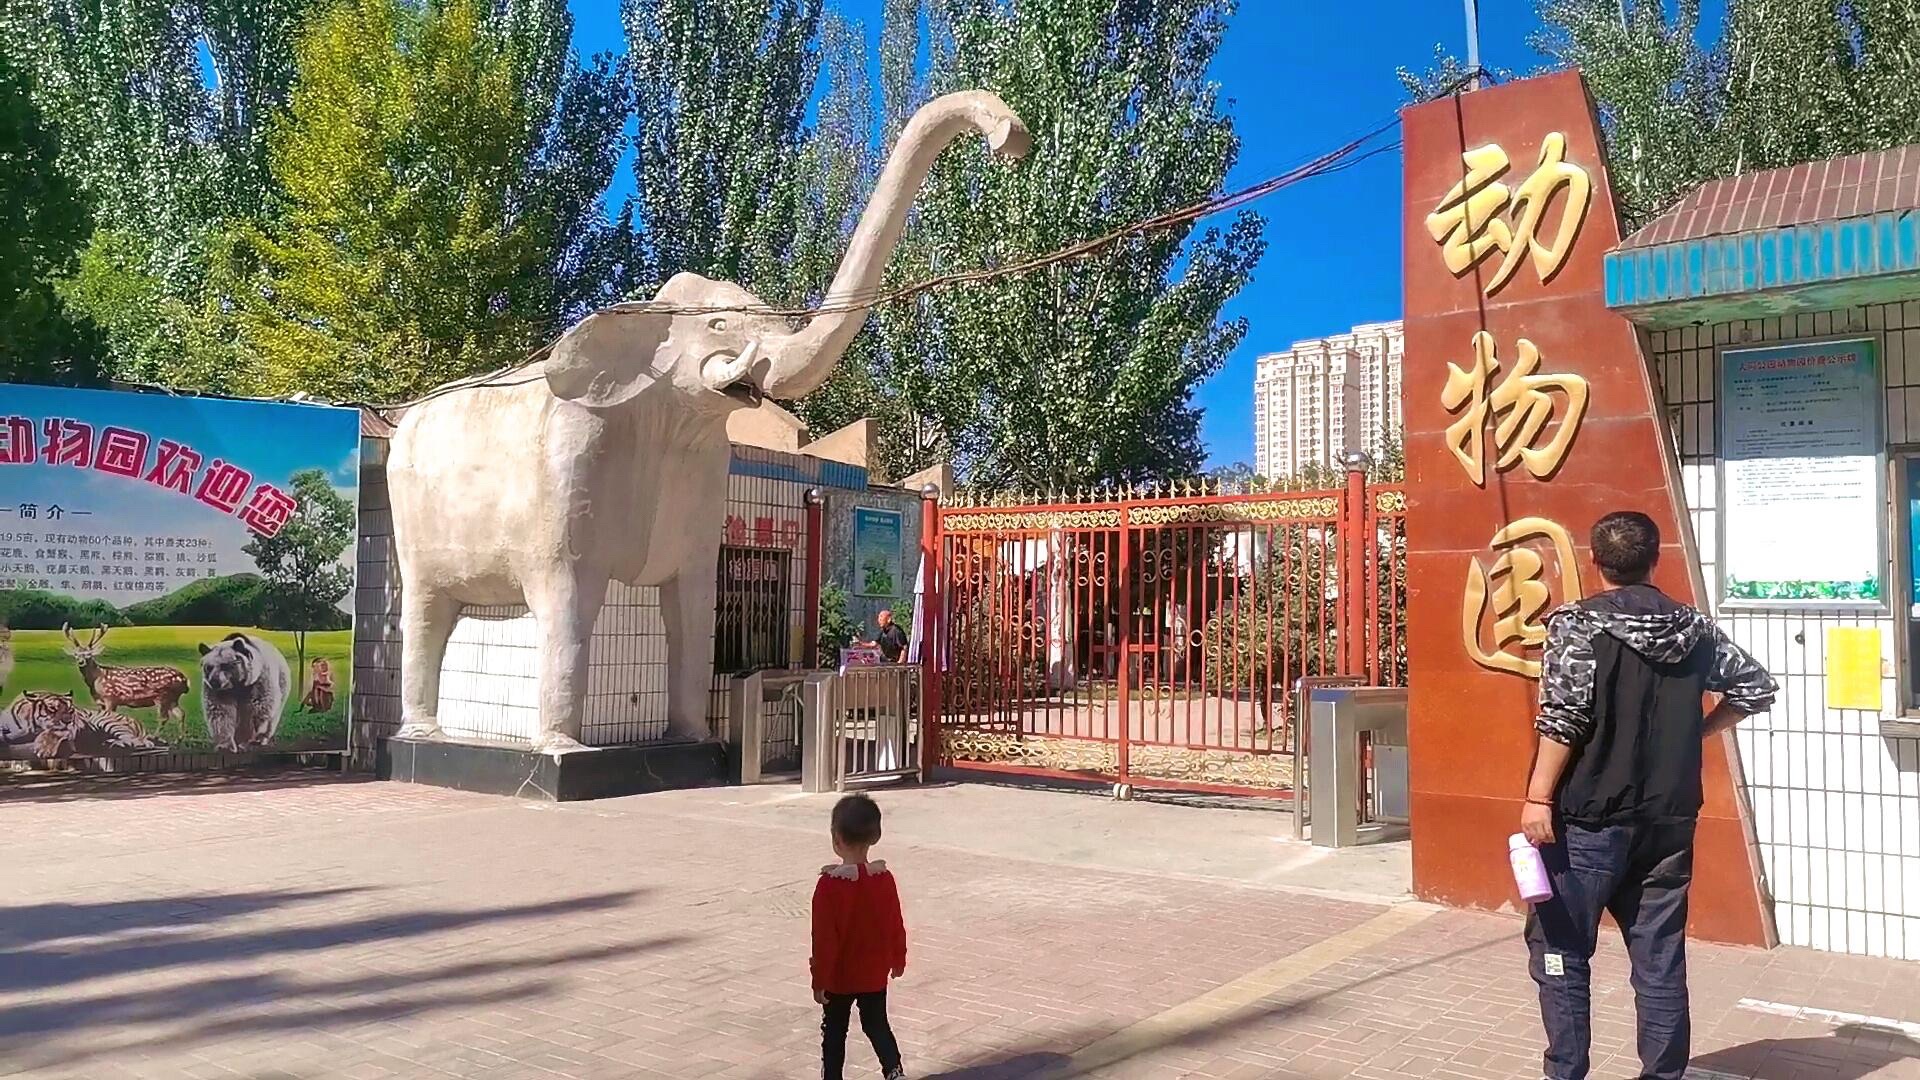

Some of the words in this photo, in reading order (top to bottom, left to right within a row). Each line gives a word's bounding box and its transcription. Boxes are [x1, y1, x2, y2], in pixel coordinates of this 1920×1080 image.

[0, 416, 298, 538] 动物园欢迎您
[1426, 131, 1591, 677] 动物园
